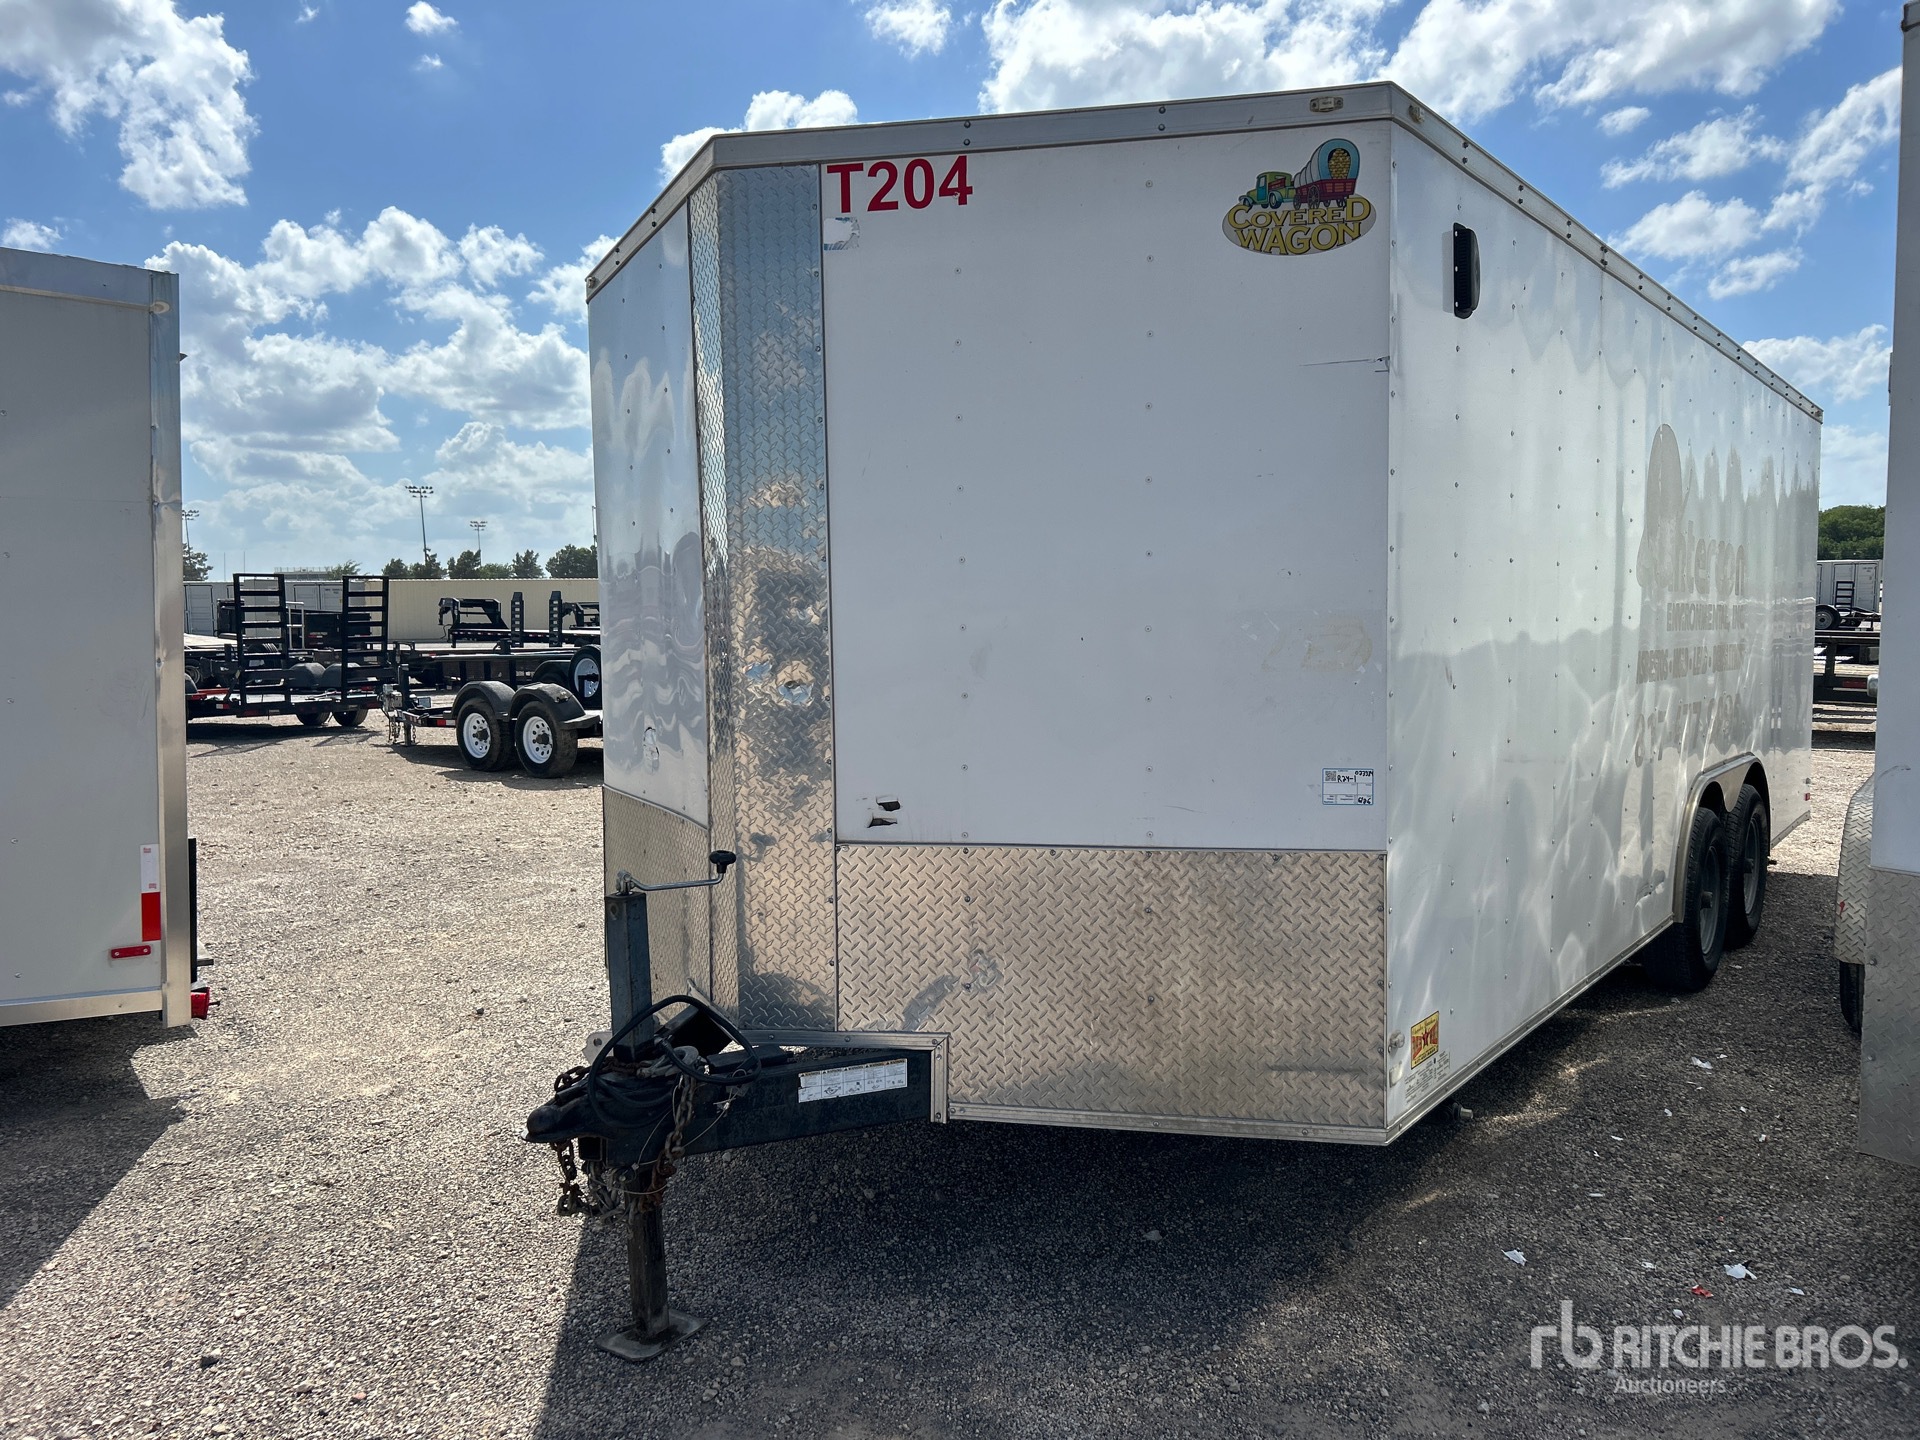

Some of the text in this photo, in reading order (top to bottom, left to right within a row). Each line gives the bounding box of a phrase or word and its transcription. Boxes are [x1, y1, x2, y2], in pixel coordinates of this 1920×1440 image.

[827, 155, 973, 213] T204
[1228, 196, 1371, 229] COVERED
[1235, 221, 1361, 255] WAGON
